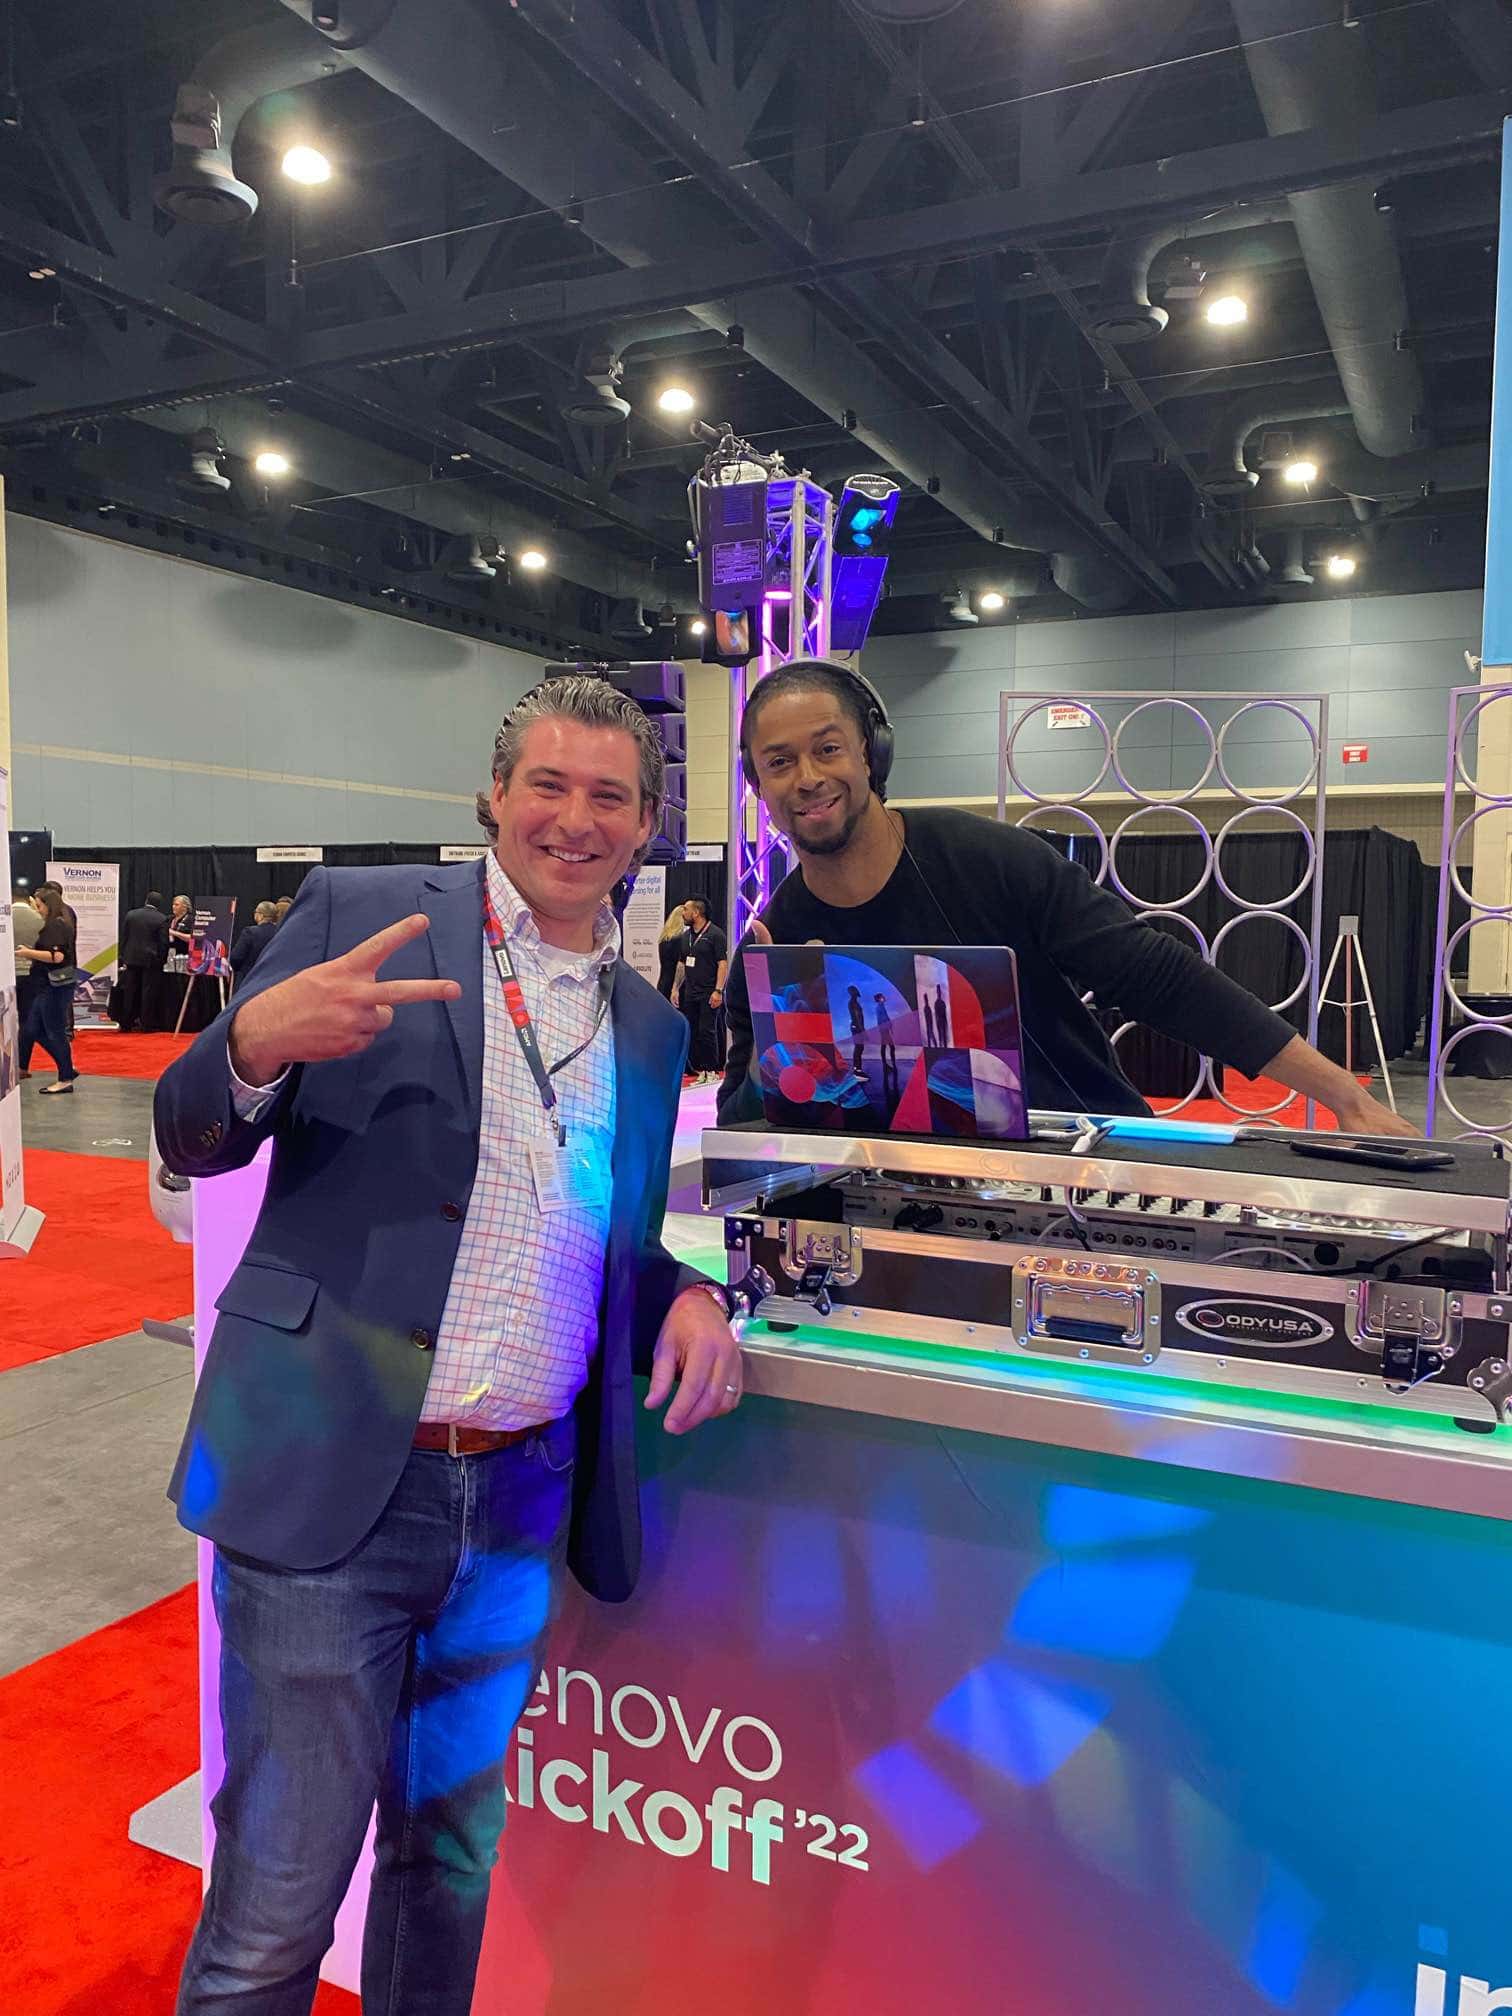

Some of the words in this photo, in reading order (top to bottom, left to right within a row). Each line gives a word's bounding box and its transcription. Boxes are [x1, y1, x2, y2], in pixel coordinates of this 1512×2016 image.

[63, 867, 102, 877] VERNON
[1226, 1315, 1313, 1332] ODYUSA
[504, 1727, 784, 1885] ickoff
